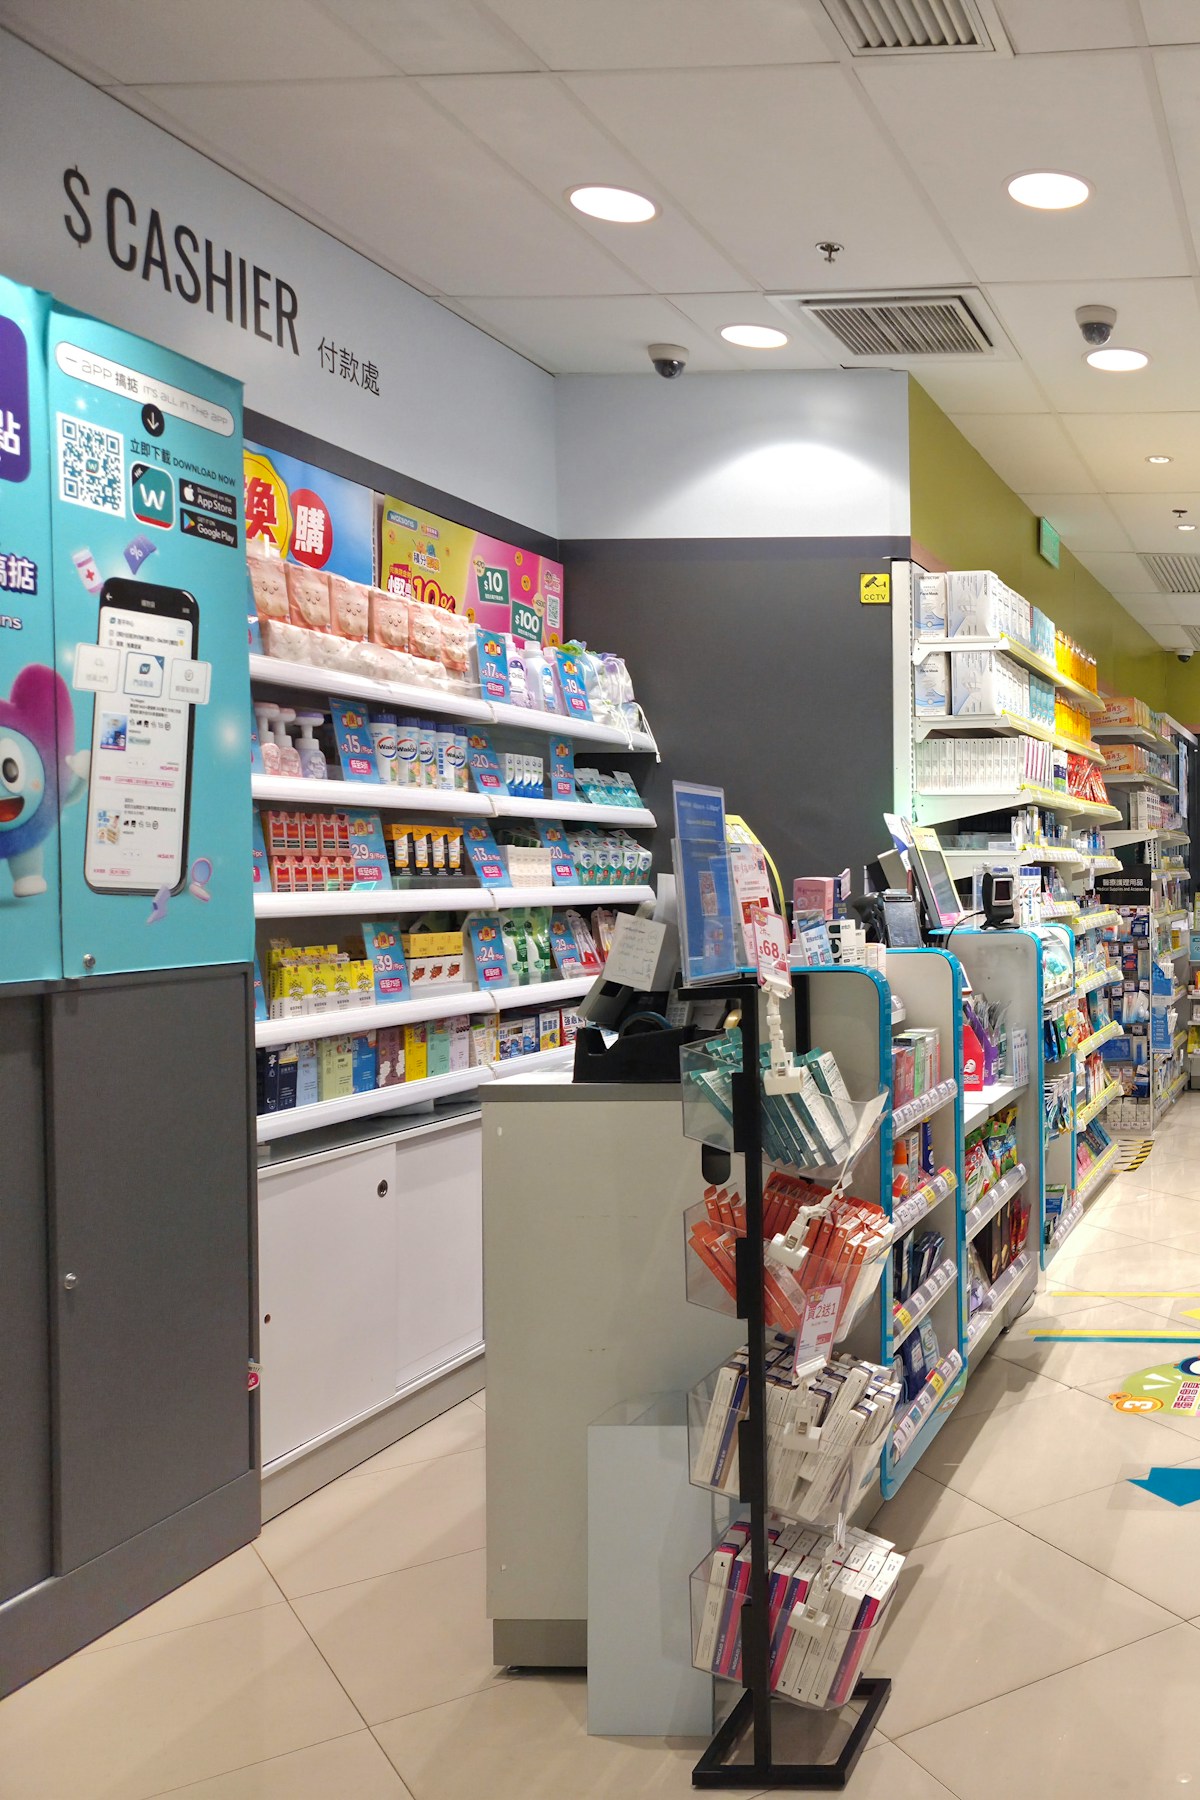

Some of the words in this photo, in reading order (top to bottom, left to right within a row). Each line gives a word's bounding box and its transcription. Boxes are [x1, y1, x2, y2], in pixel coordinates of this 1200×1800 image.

[105, 188, 300, 357] CASHIER
[317, 336, 381, 396] 付款處
[114, 372, 138, 393] 搞掂
[130, 438, 171, 464] 立即下載
[173, 457, 217, 481] DOWNLOAD
[218, 474, 236, 487] NOW
[197, 496, 212, 509] App
[213, 499, 233, 515] Store
[197, 523, 220, 539] Google
[221, 528, 235, 545] Play
[294, 505, 325, 556] 購
[484, 571, 503, 592] $10
[863, 592, 887, 602] CCTV
[514, 609, 541, 633] $100
[807, 1303, 836, 1321] 買2送1
